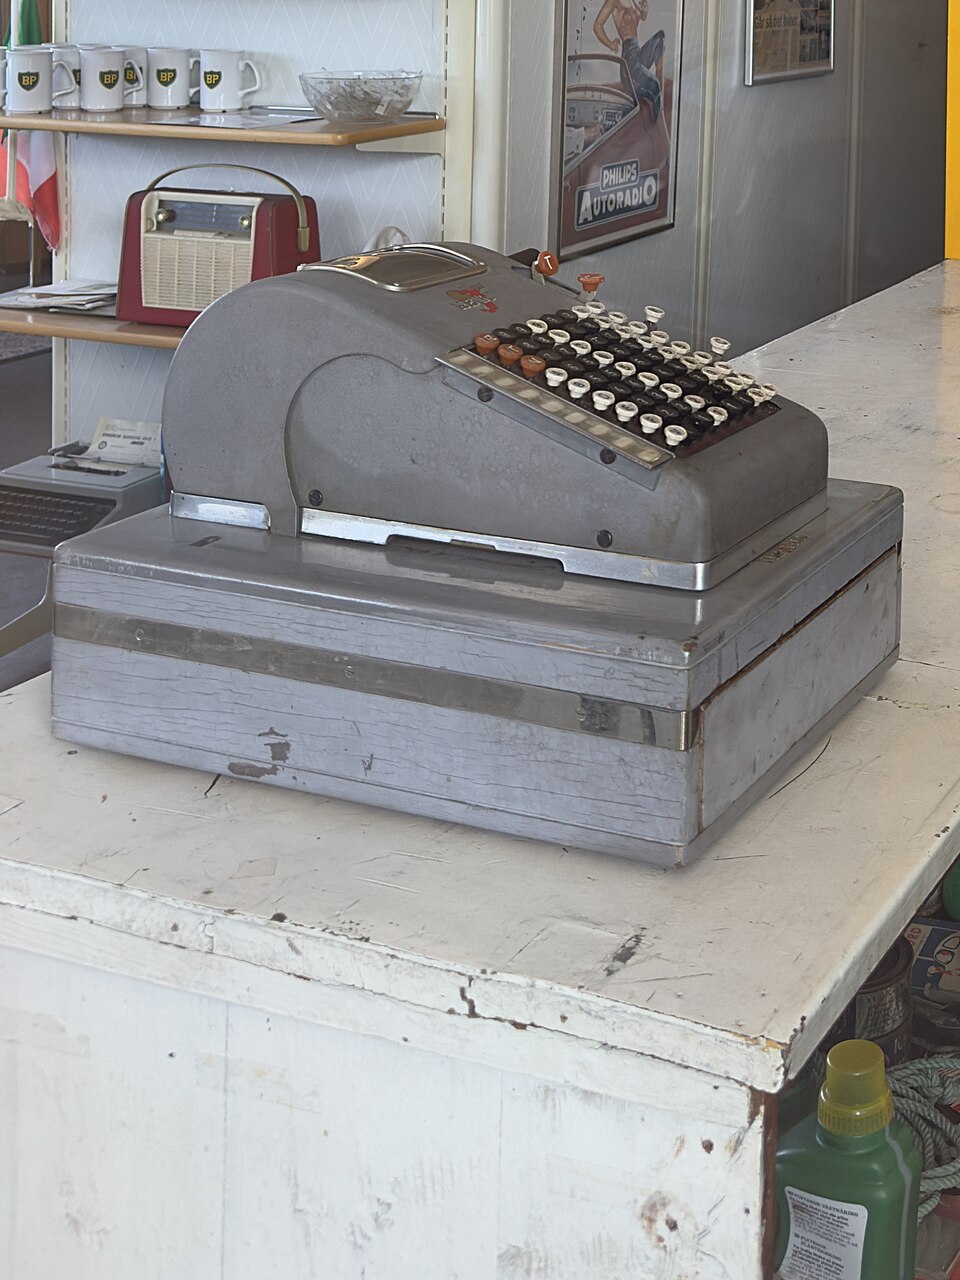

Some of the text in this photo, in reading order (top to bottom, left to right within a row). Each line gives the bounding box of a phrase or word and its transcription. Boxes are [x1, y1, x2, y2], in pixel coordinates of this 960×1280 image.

[22, 74, 37, 86] BP
[103, 75, 118, 85] BP
[160, 72, 174, 82] BP
[206, 74, 220, 85] BP
[602, 163, 637, 187] PHILIPS
[577, 175, 657, 225] AUTORADIO
